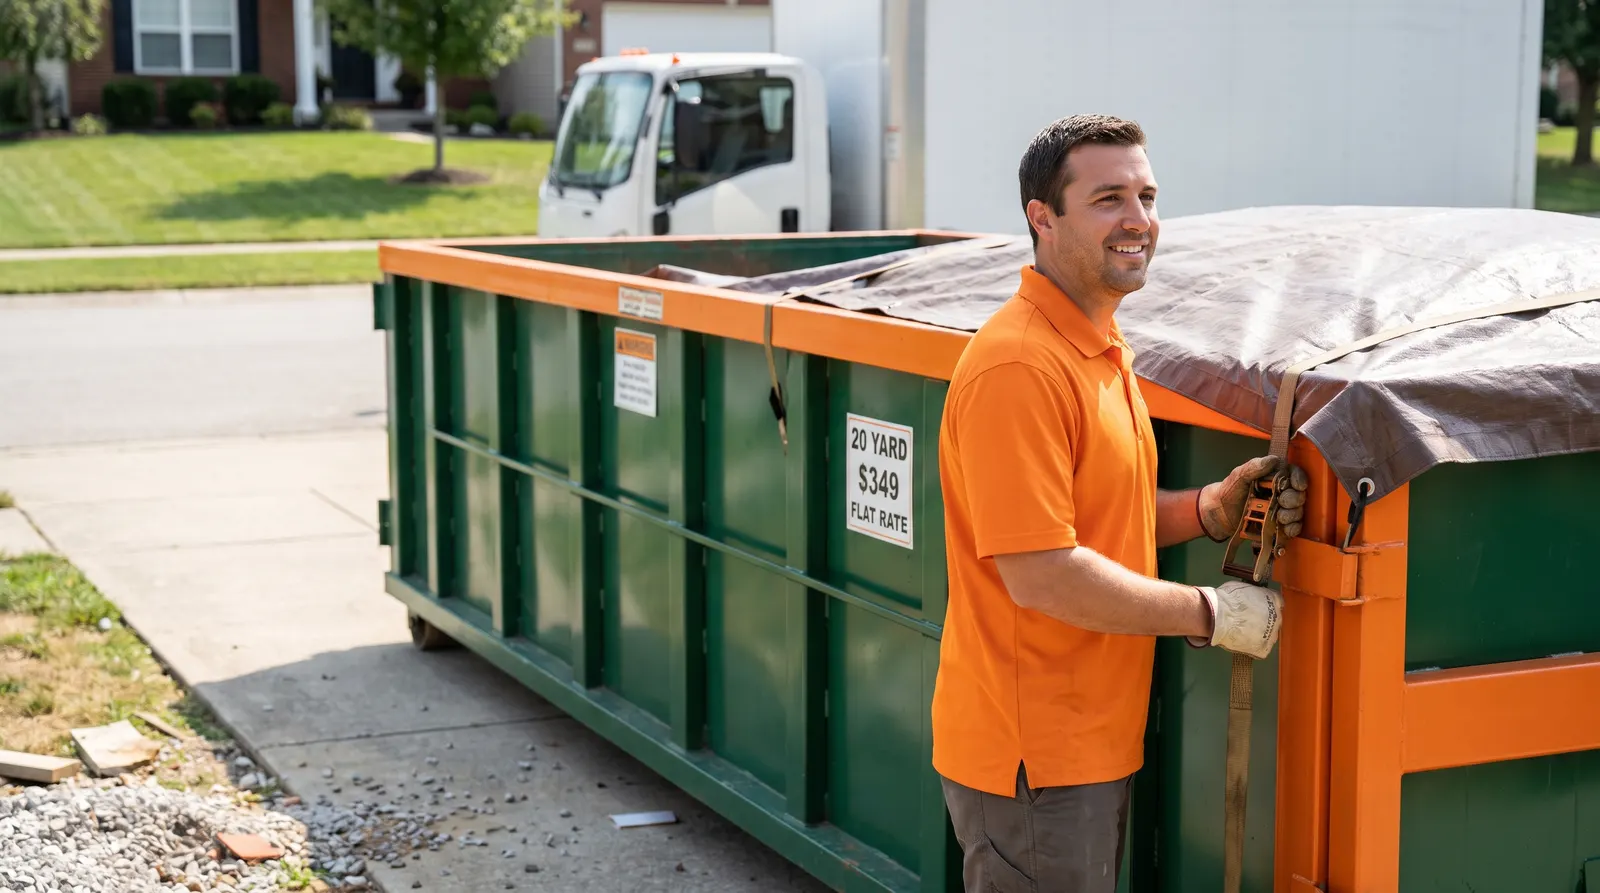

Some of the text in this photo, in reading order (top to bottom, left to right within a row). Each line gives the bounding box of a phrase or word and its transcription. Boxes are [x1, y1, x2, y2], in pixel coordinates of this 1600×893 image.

[851, 427, 908, 461] 20 YARD
[858, 462, 899, 501] $349
[851, 501, 908, 534] FLAT RATE
